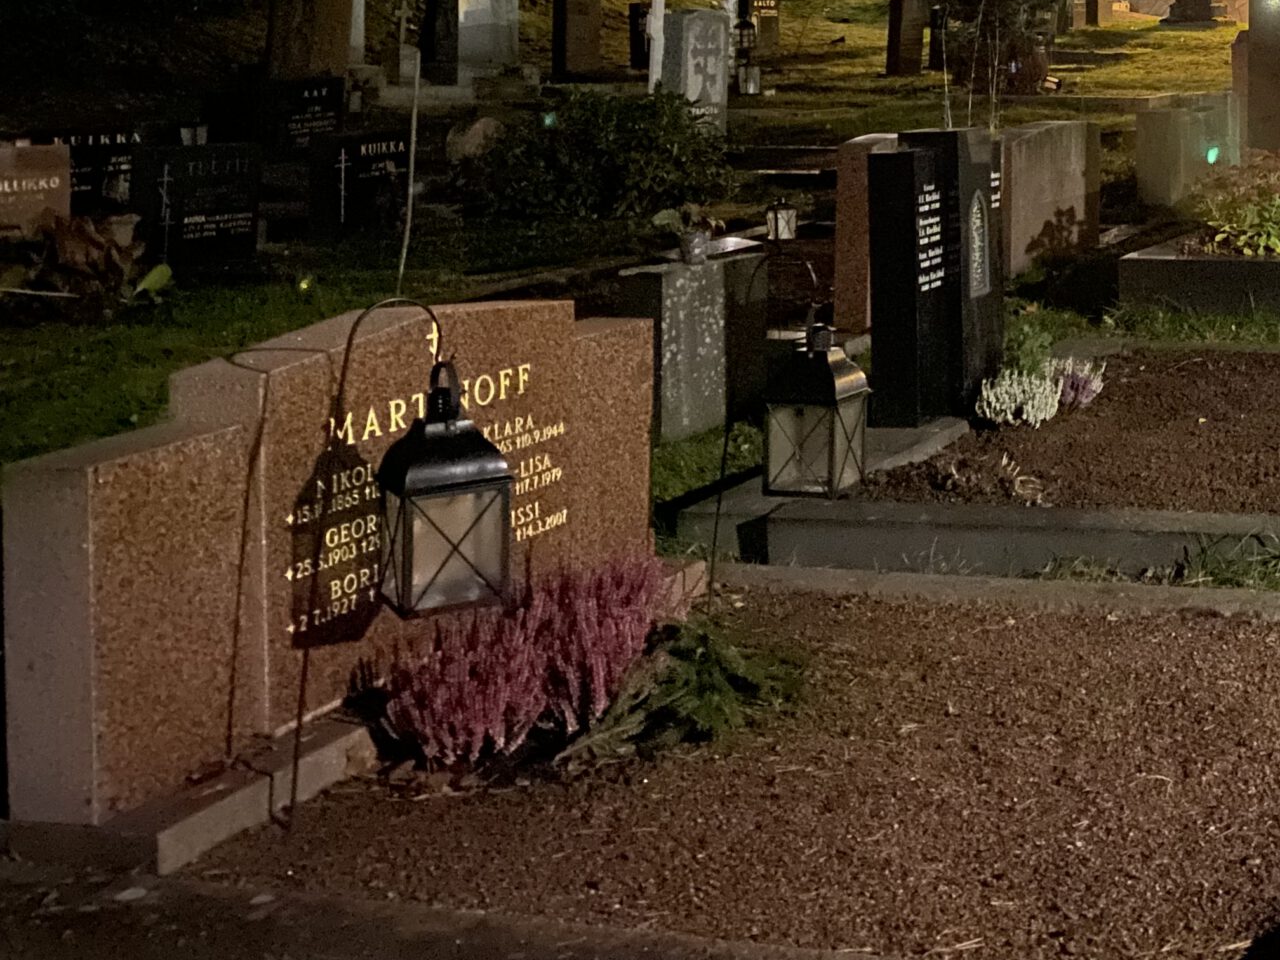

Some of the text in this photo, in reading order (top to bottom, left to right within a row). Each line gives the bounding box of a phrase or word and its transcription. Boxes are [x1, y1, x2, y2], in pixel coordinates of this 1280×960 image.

[360, 141, 405, 157] KUIKKA
[0, 176, 60, 193] LLIKKO
[329, 364, 531, 446] MARTNOFF
[483, 414, 534, 442] KLARA
[325, 514, 382, 548] GEOR
